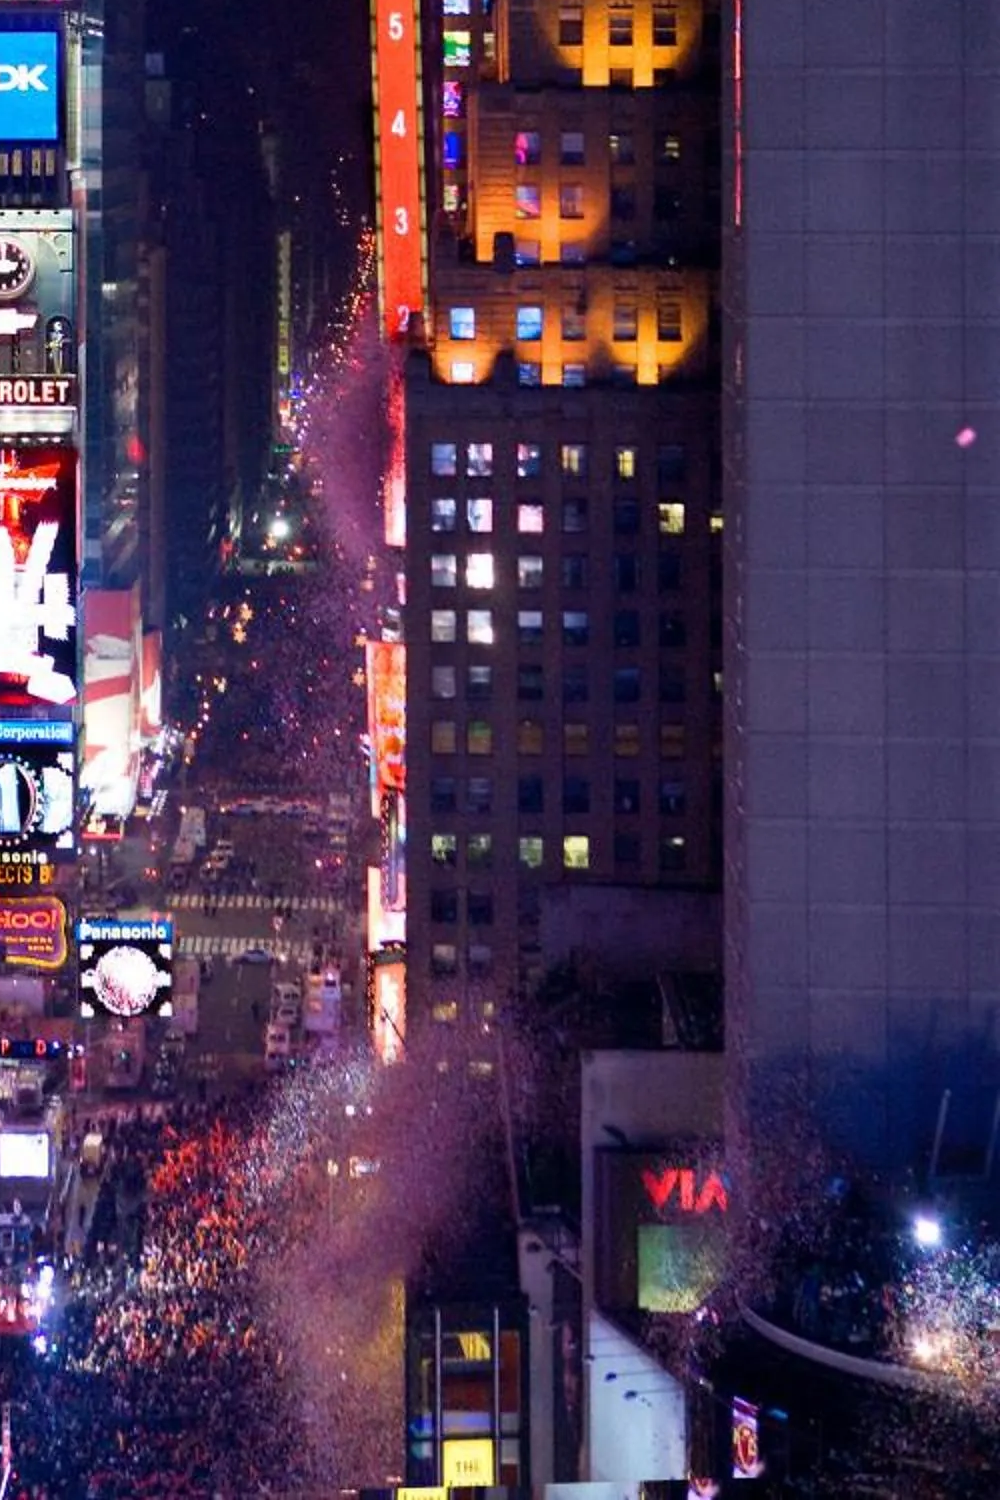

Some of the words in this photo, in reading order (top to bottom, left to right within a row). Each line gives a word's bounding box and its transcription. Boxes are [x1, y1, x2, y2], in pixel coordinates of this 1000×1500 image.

[388, 12, 403, 40] 5
[391, 110, 406, 138] 4
[394, 206, 409, 236] 3
[80, 922, 167, 940] Panasonic
